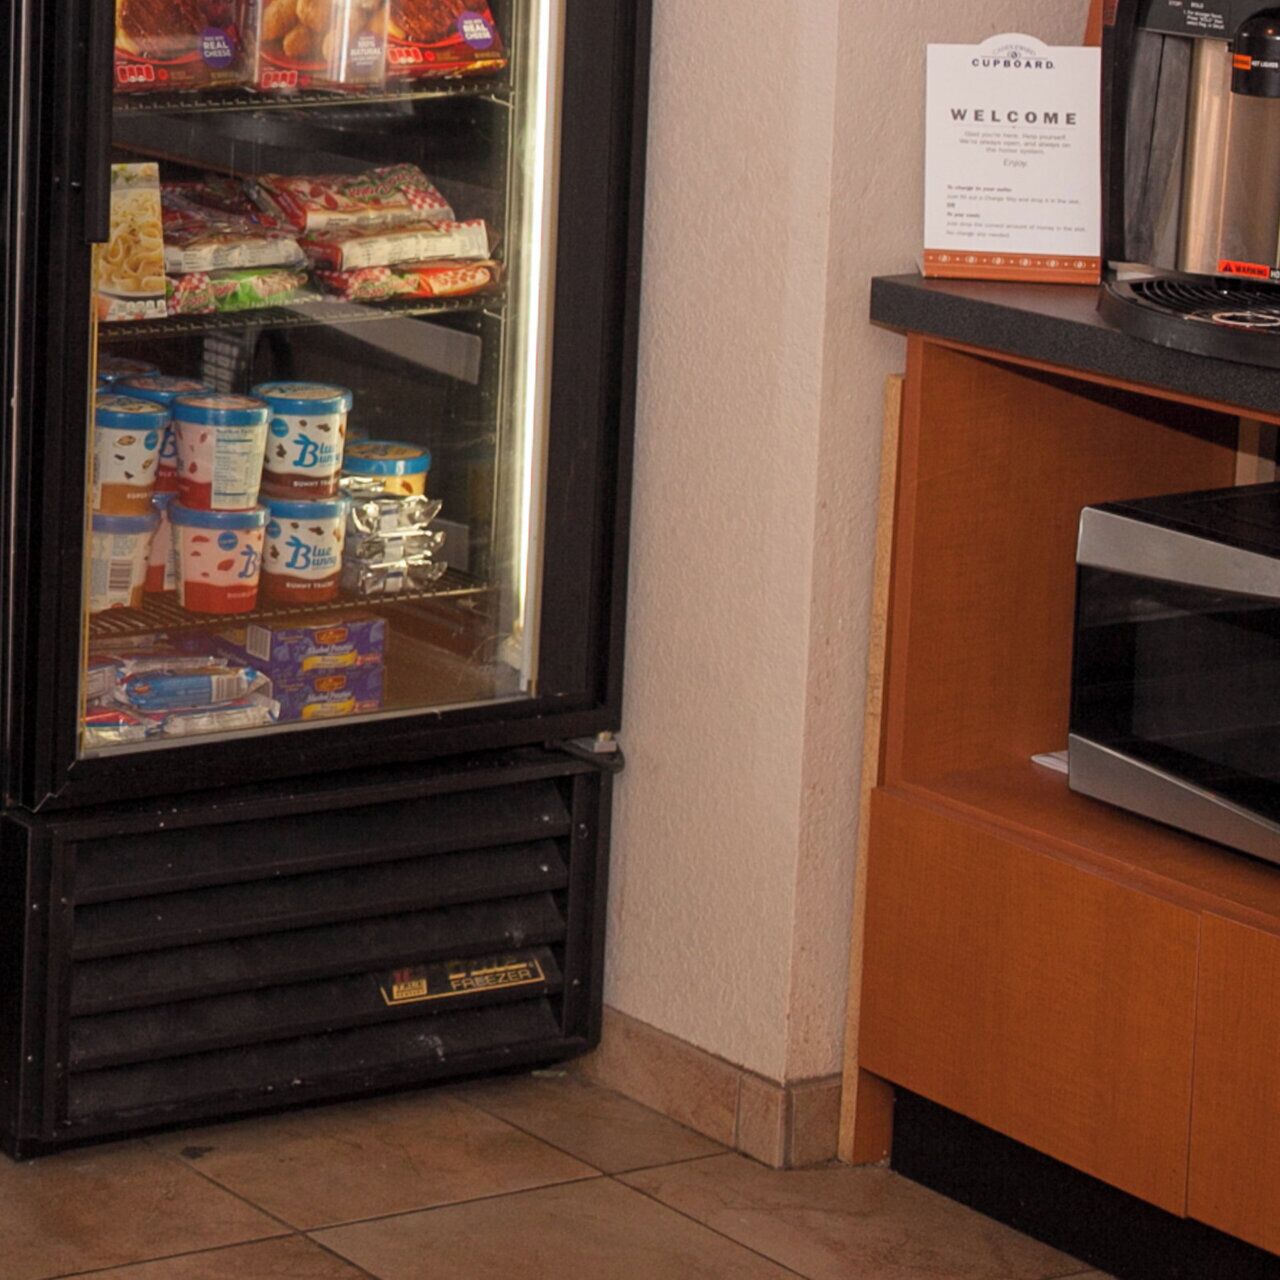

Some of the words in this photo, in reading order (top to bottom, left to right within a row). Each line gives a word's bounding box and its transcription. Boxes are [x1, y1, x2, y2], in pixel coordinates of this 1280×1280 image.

[203, 41, 228, 51] REAL
[972, 58, 1054, 69] CUPBOARD
[951, 108, 1077, 125] WELCOME
